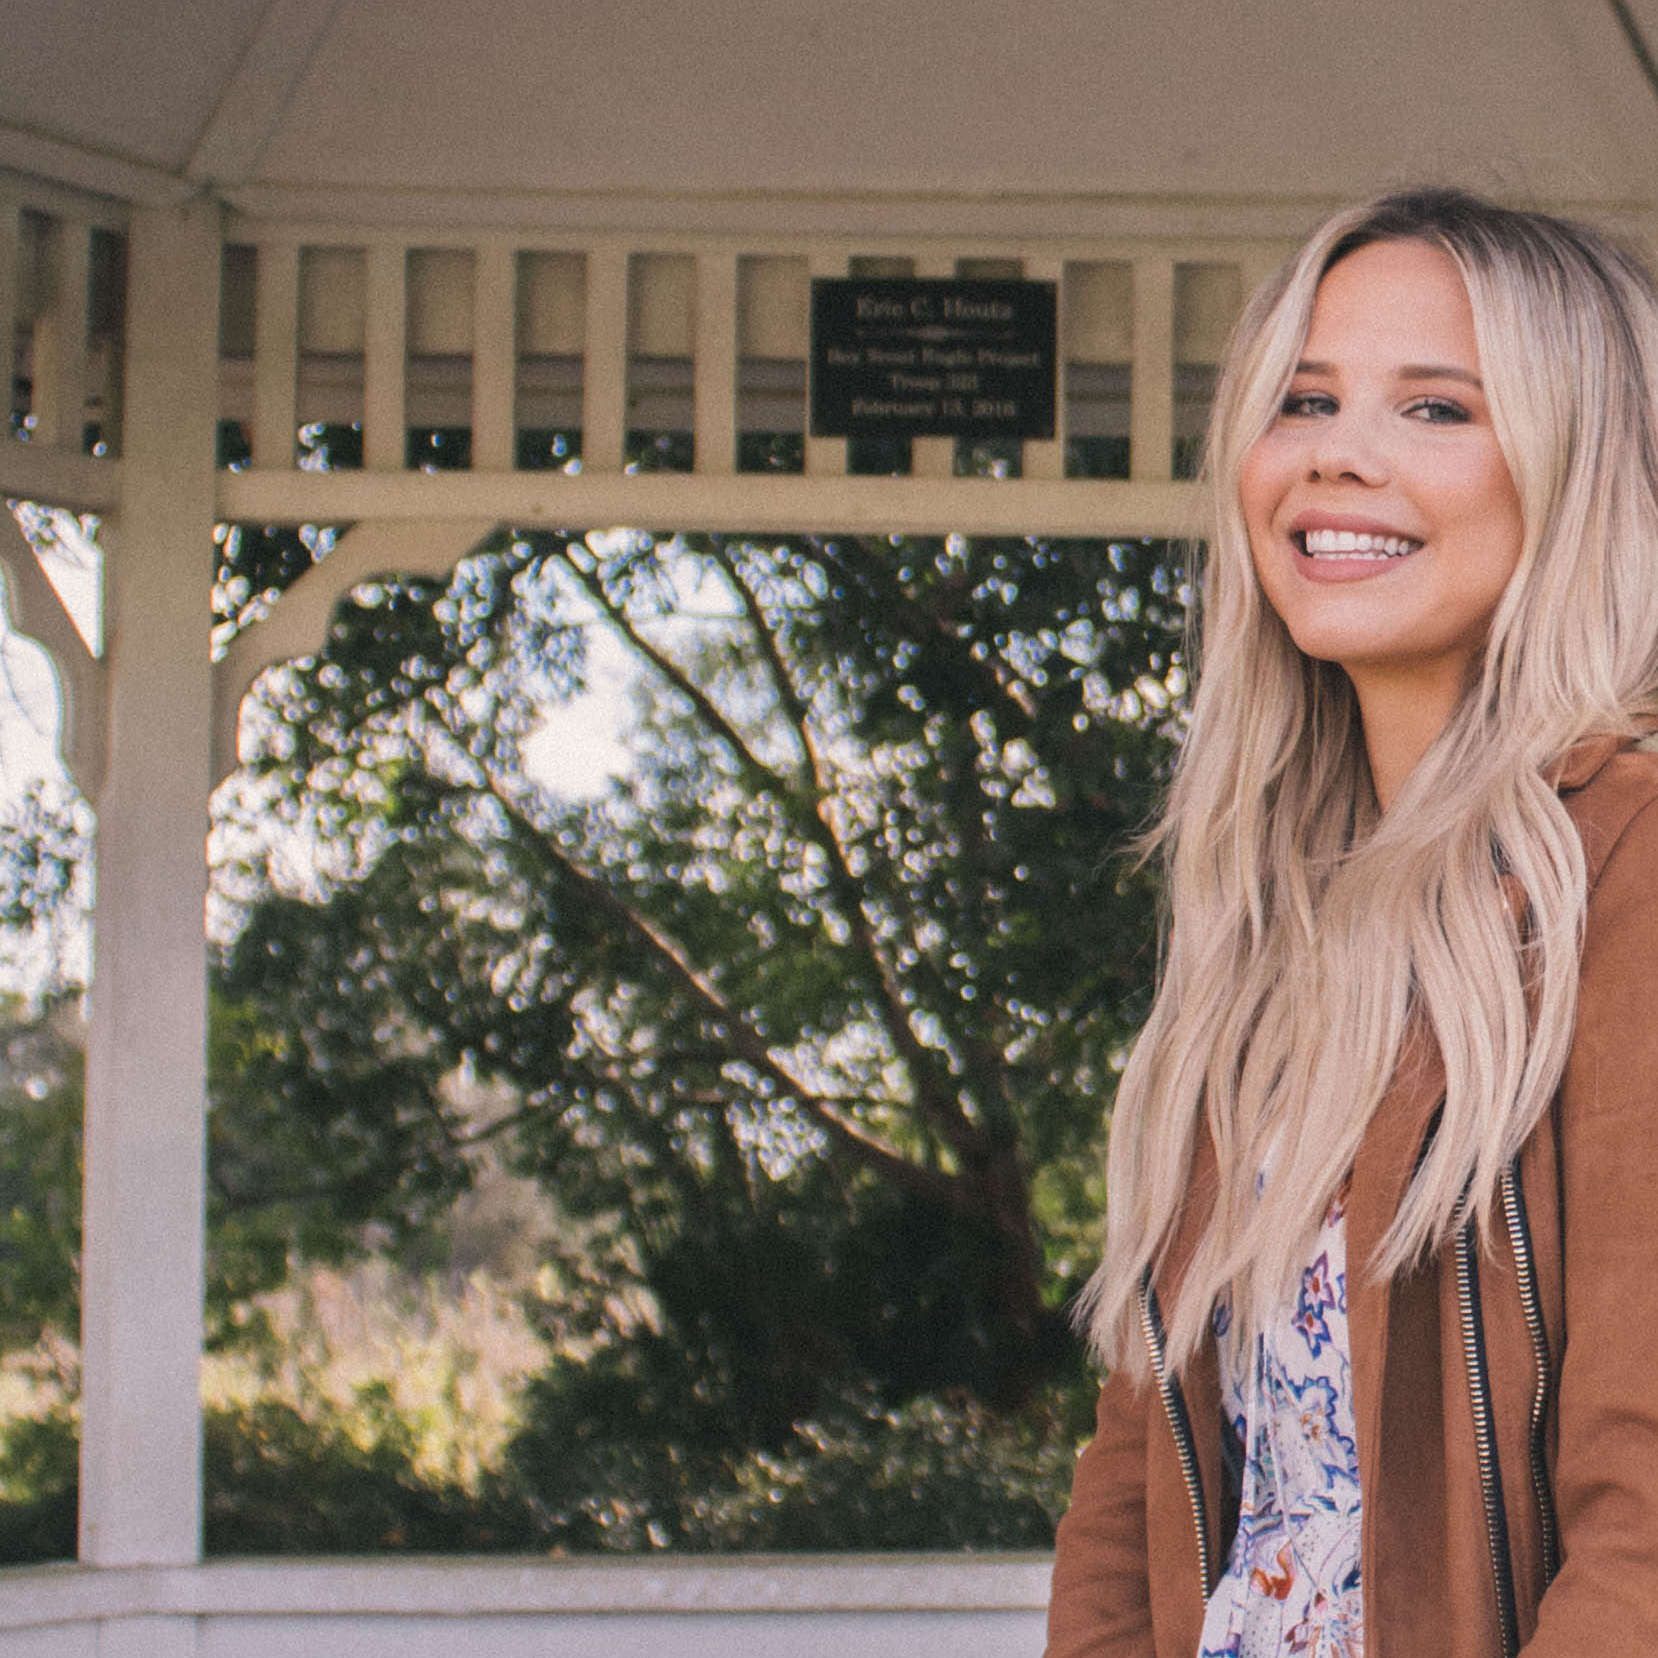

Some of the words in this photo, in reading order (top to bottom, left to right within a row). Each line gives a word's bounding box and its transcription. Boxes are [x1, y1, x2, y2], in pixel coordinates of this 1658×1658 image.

[828, 347, 862, 367] Boy
[866, 347, 917, 364] Scout
[921, 348, 973, 368] Eagle
[977, 349, 1041, 369] Project
[889, 372, 942, 393] Troop
[852, 398, 936, 419] February
